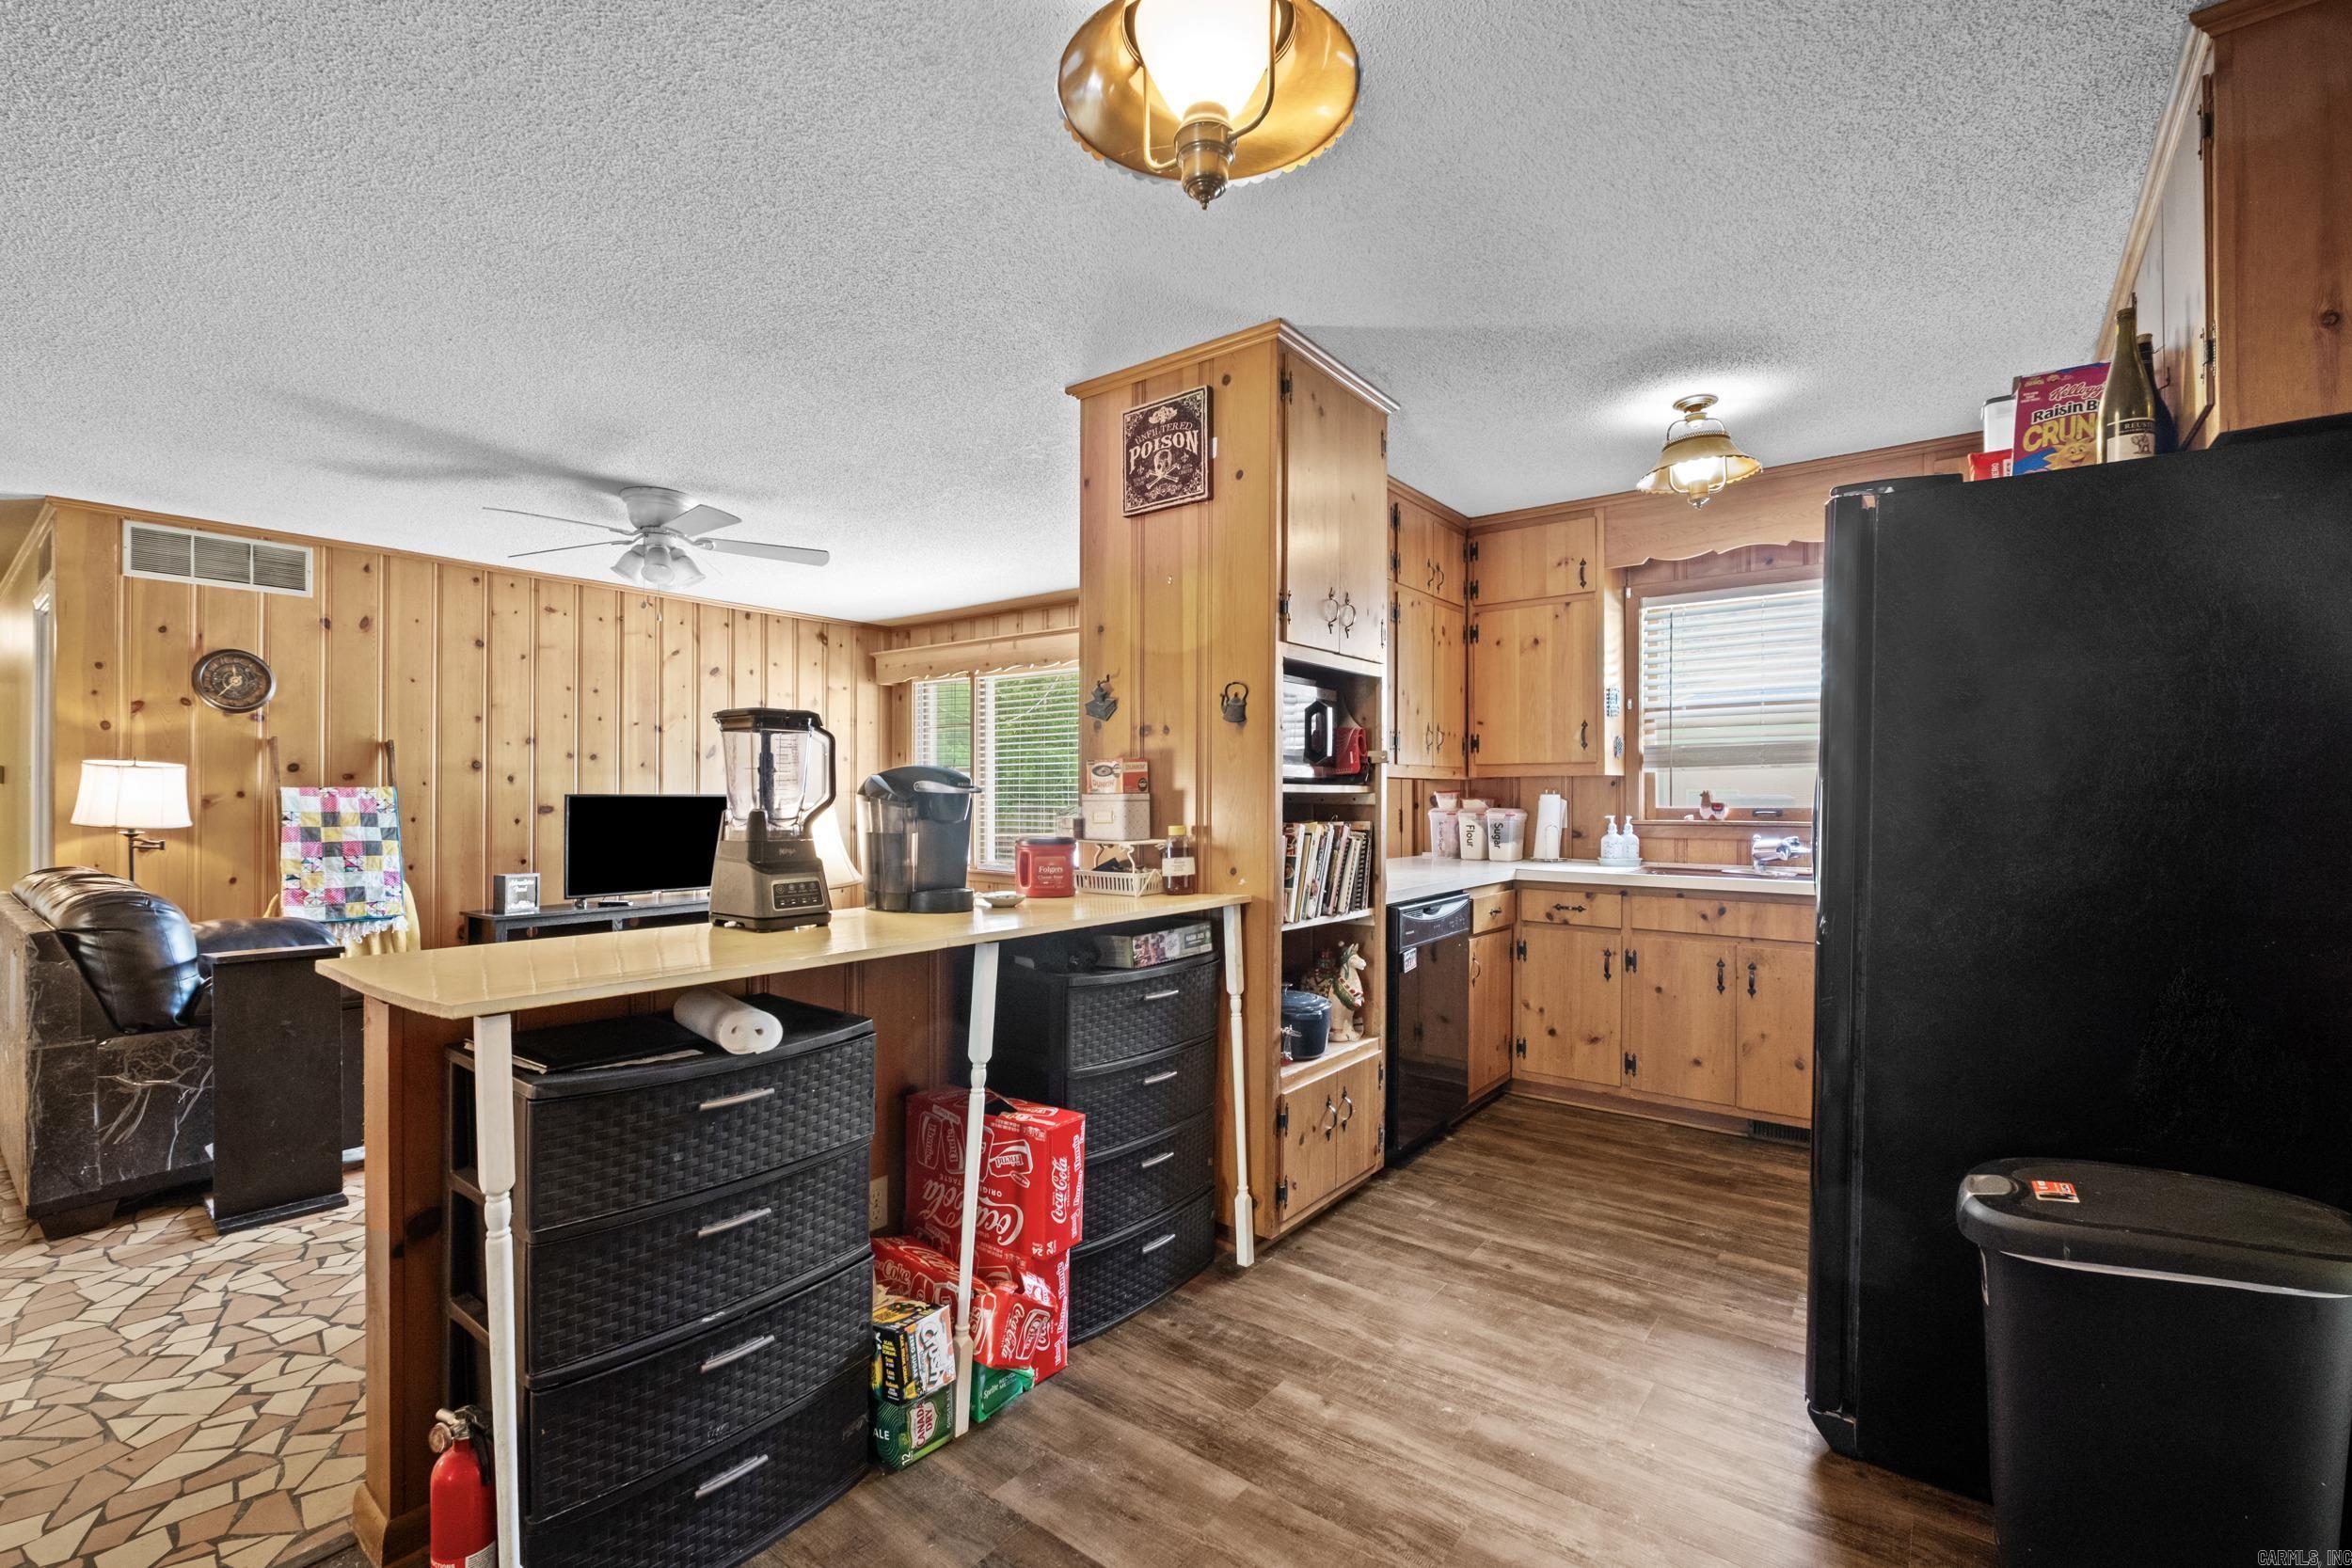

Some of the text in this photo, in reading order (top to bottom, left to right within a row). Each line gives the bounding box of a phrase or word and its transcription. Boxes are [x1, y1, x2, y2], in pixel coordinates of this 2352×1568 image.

[2032, 402, 2083, 425] Raisin
[1135, 421, 1193, 445] UNFILTERED
[2023, 413, 2099, 452] CRUN
[1129, 430, 1200, 474] POISON
[1466, 824, 1475, 847] Flour
[1491, 822, 1503, 849] Sugar
[1039, 864, 1063, 875] Folgers
[994, 1153, 1025, 1168] Friend
[978, 1186, 1002, 1197] ORIGI
[1051, 1156, 1067, 1224] Coca-Cola
[883, 1259, 911, 1284] Coke
[1001, 1303, 1025, 1362] Coca-Cola
[911, 1354, 919, 1380] SUGAR
[919, 1323, 945, 1387] Crush
[983, 1384, 999, 1400] Sprite
[916, 1402, 926, 1448] CANADA
[925, 1409, 933, 1433] DRY
[873, 1428, 890, 1441] ALE
[901, 1451, 911, 1465] 12
